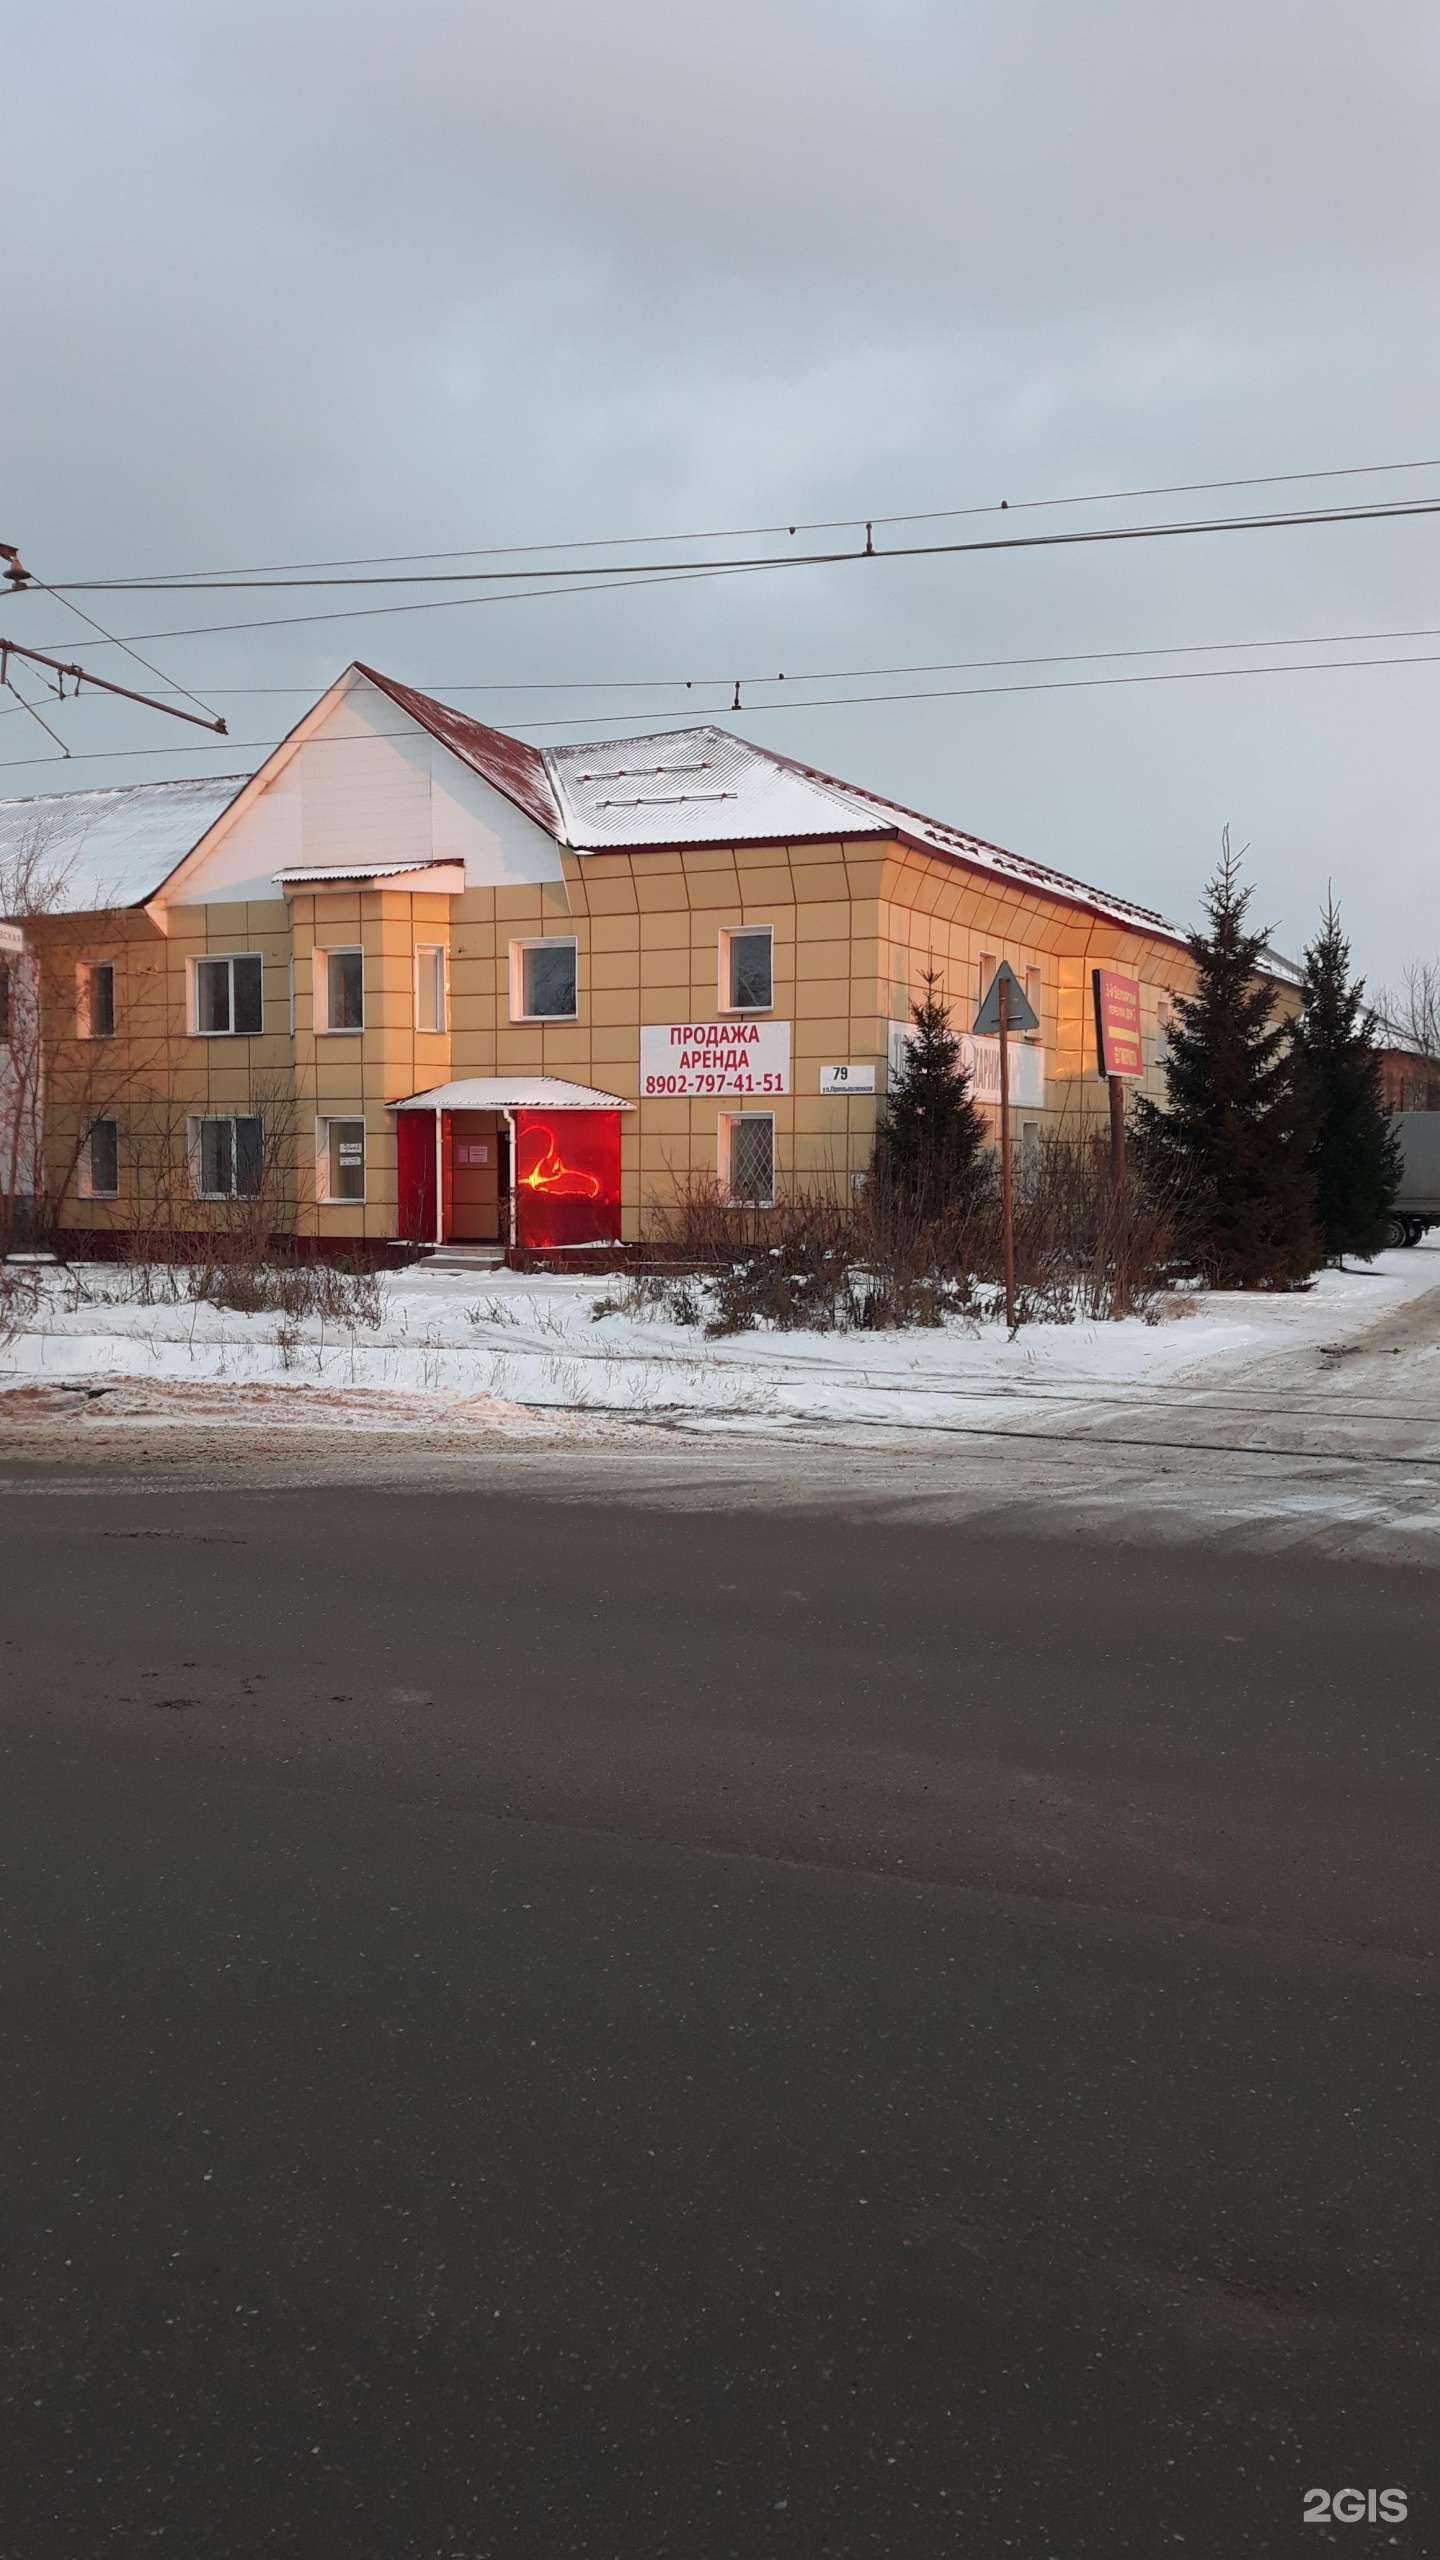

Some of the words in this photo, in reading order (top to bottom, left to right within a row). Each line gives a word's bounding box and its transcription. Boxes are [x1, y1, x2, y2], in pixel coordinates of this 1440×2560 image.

[670, 1025, 760, 1047] ПРОДАЖА
[680, 1050, 749, 1071] АРЕНДА
[646, 1073, 784, 1094] 8902-797-41-51
[832, 1067, 848, 1080] 79
